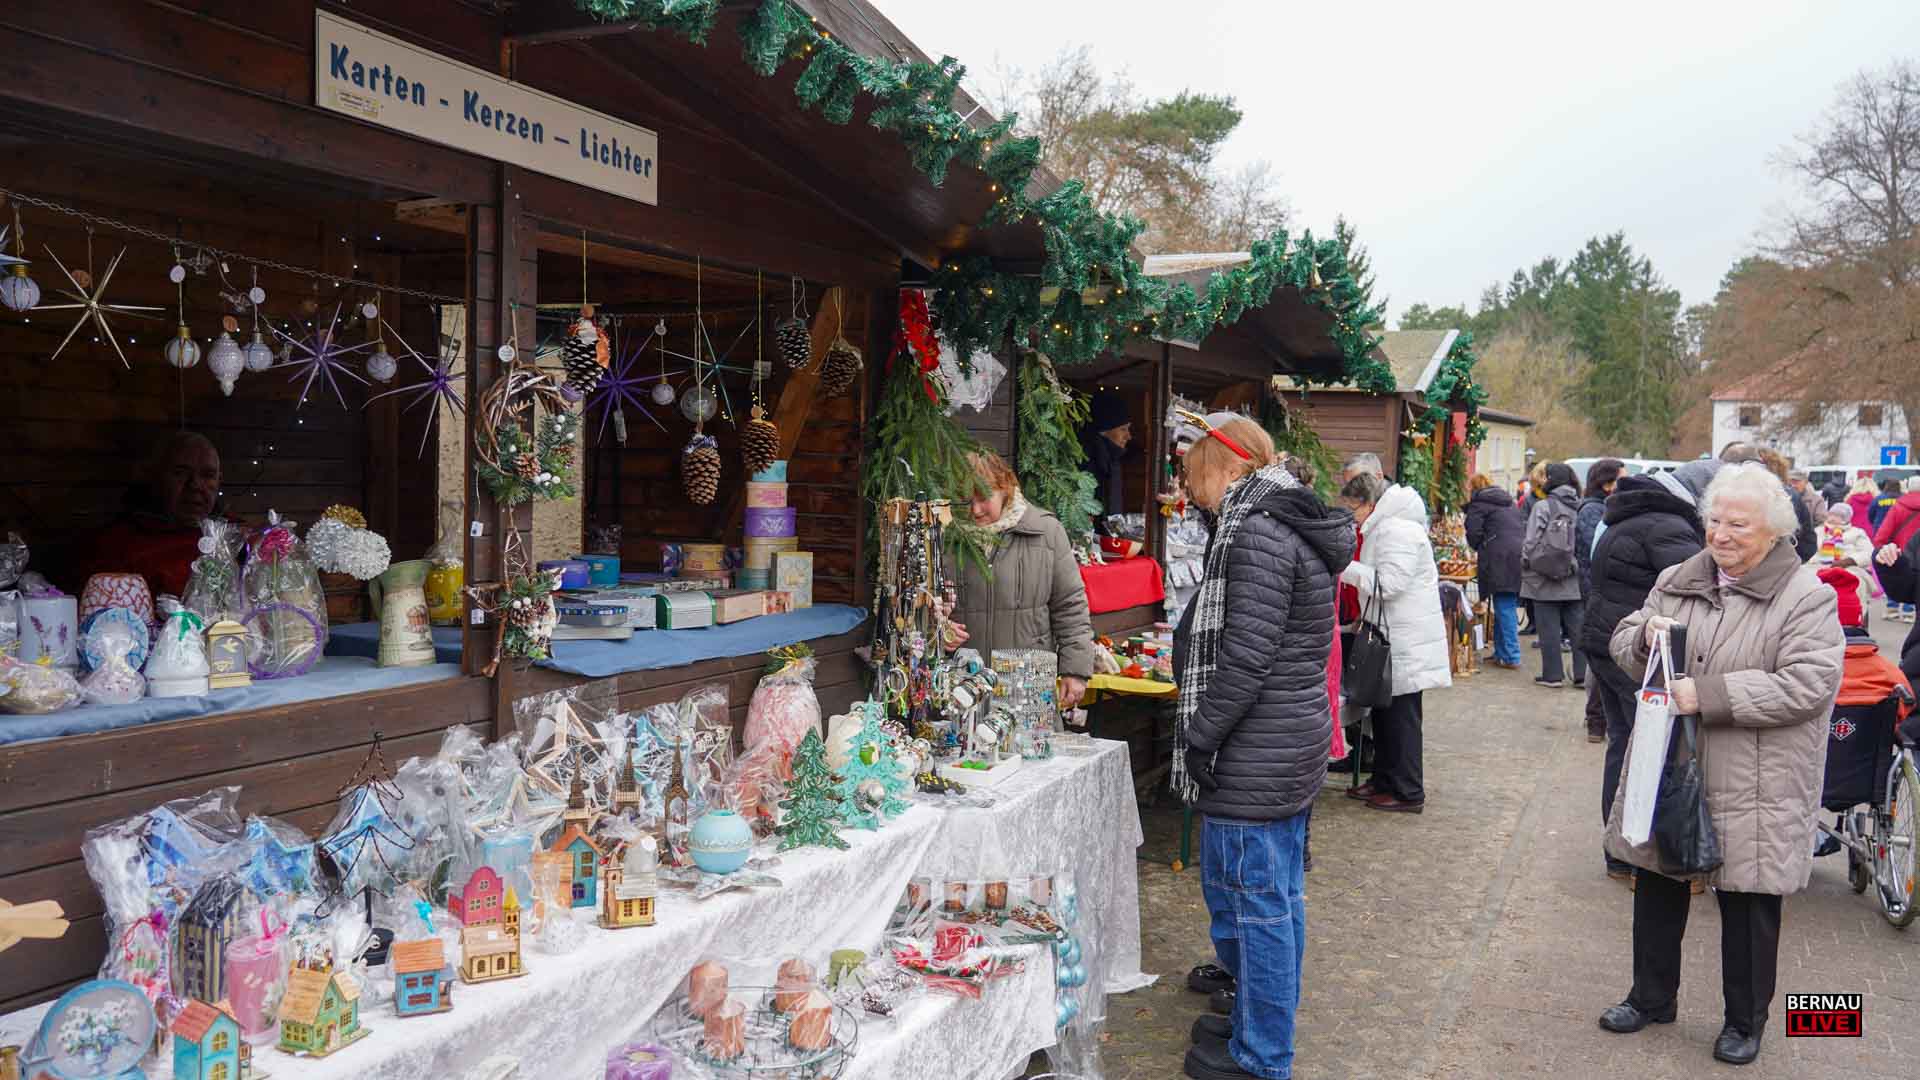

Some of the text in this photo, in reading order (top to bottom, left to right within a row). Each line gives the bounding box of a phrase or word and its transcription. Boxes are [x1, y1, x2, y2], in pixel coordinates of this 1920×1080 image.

[330, 42, 426, 107] Karten
[463, 88, 544, 145] Kerzen
[580, 127, 652, 178] Lichter
